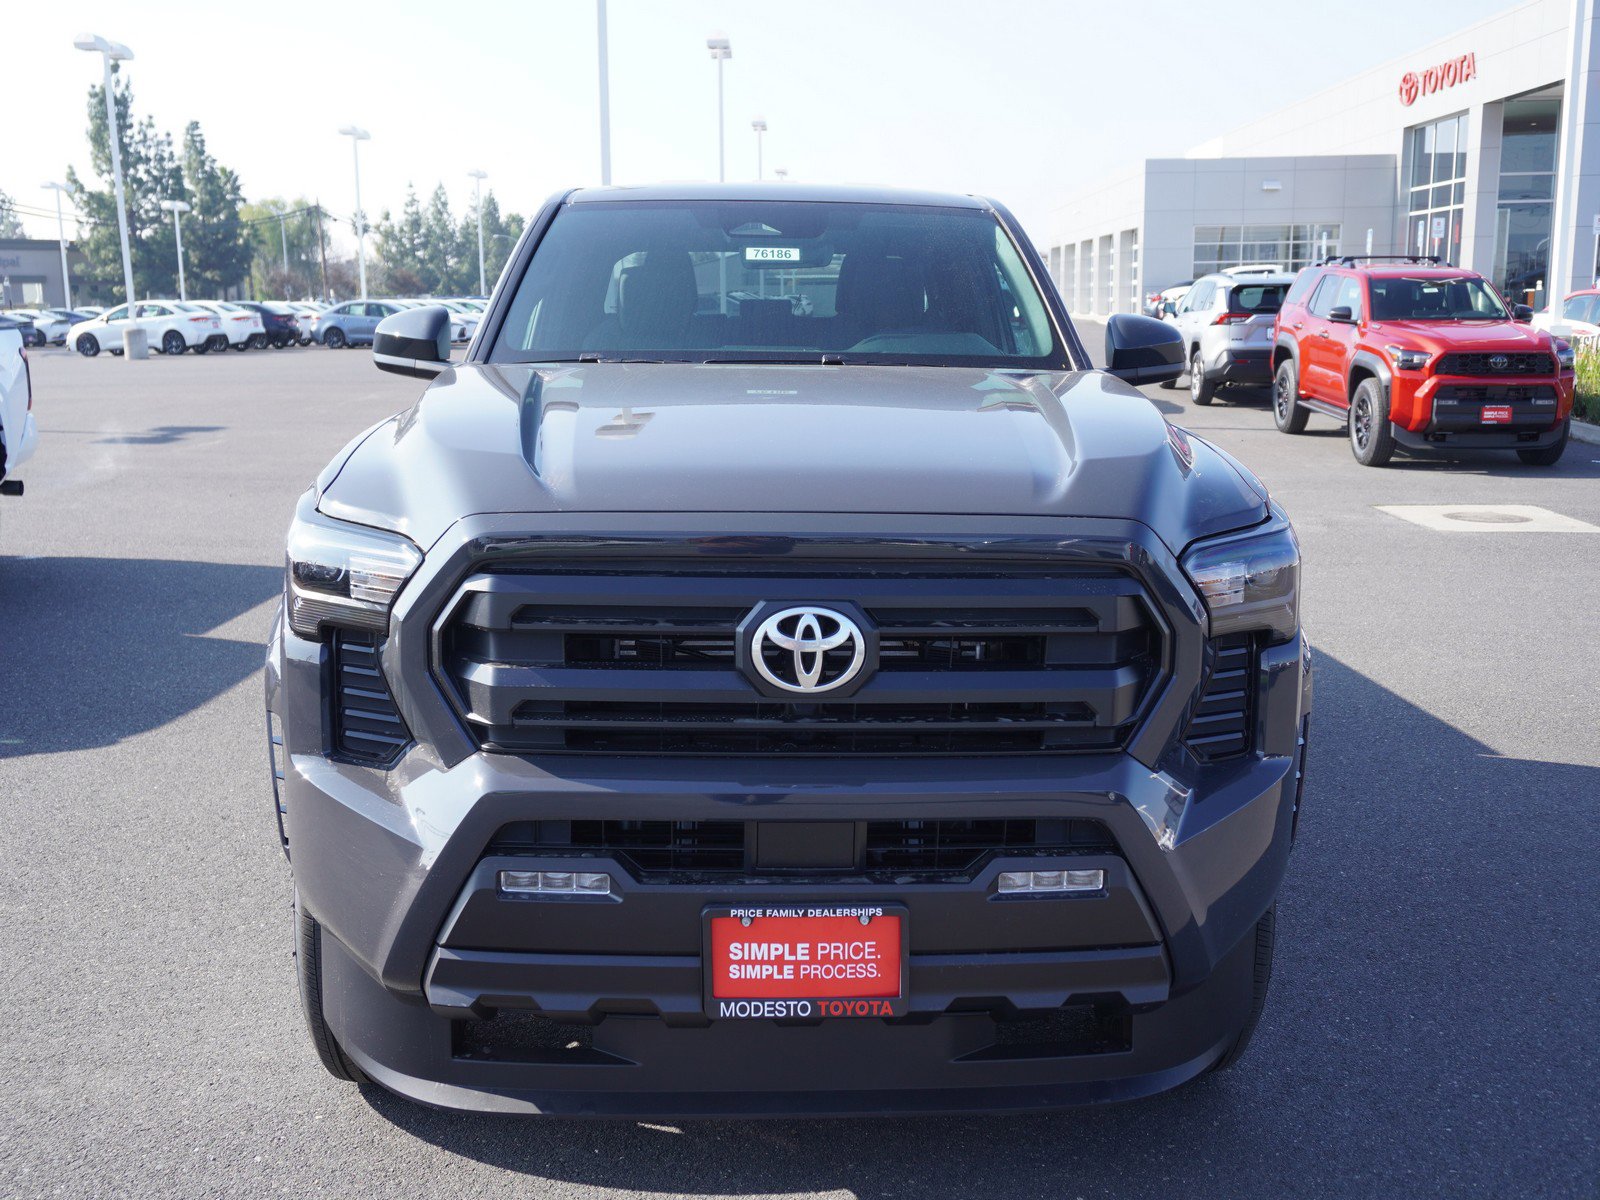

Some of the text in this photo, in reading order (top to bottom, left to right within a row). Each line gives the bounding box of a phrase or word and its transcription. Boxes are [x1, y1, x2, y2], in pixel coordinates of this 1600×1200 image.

[1420, 52, 1477, 97] TOYOTA
[753, 249, 792, 259] 76186
[730, 908, 883, 918] PRICE FAMILY DEALERSHIPS
[729, 941, 881, 961] SIMPLE PRICE.
[729, 963, 881, 979] SIMPLE PROCESS.
[720, 1001, 894, 1018] MODESTO TOYOTA
